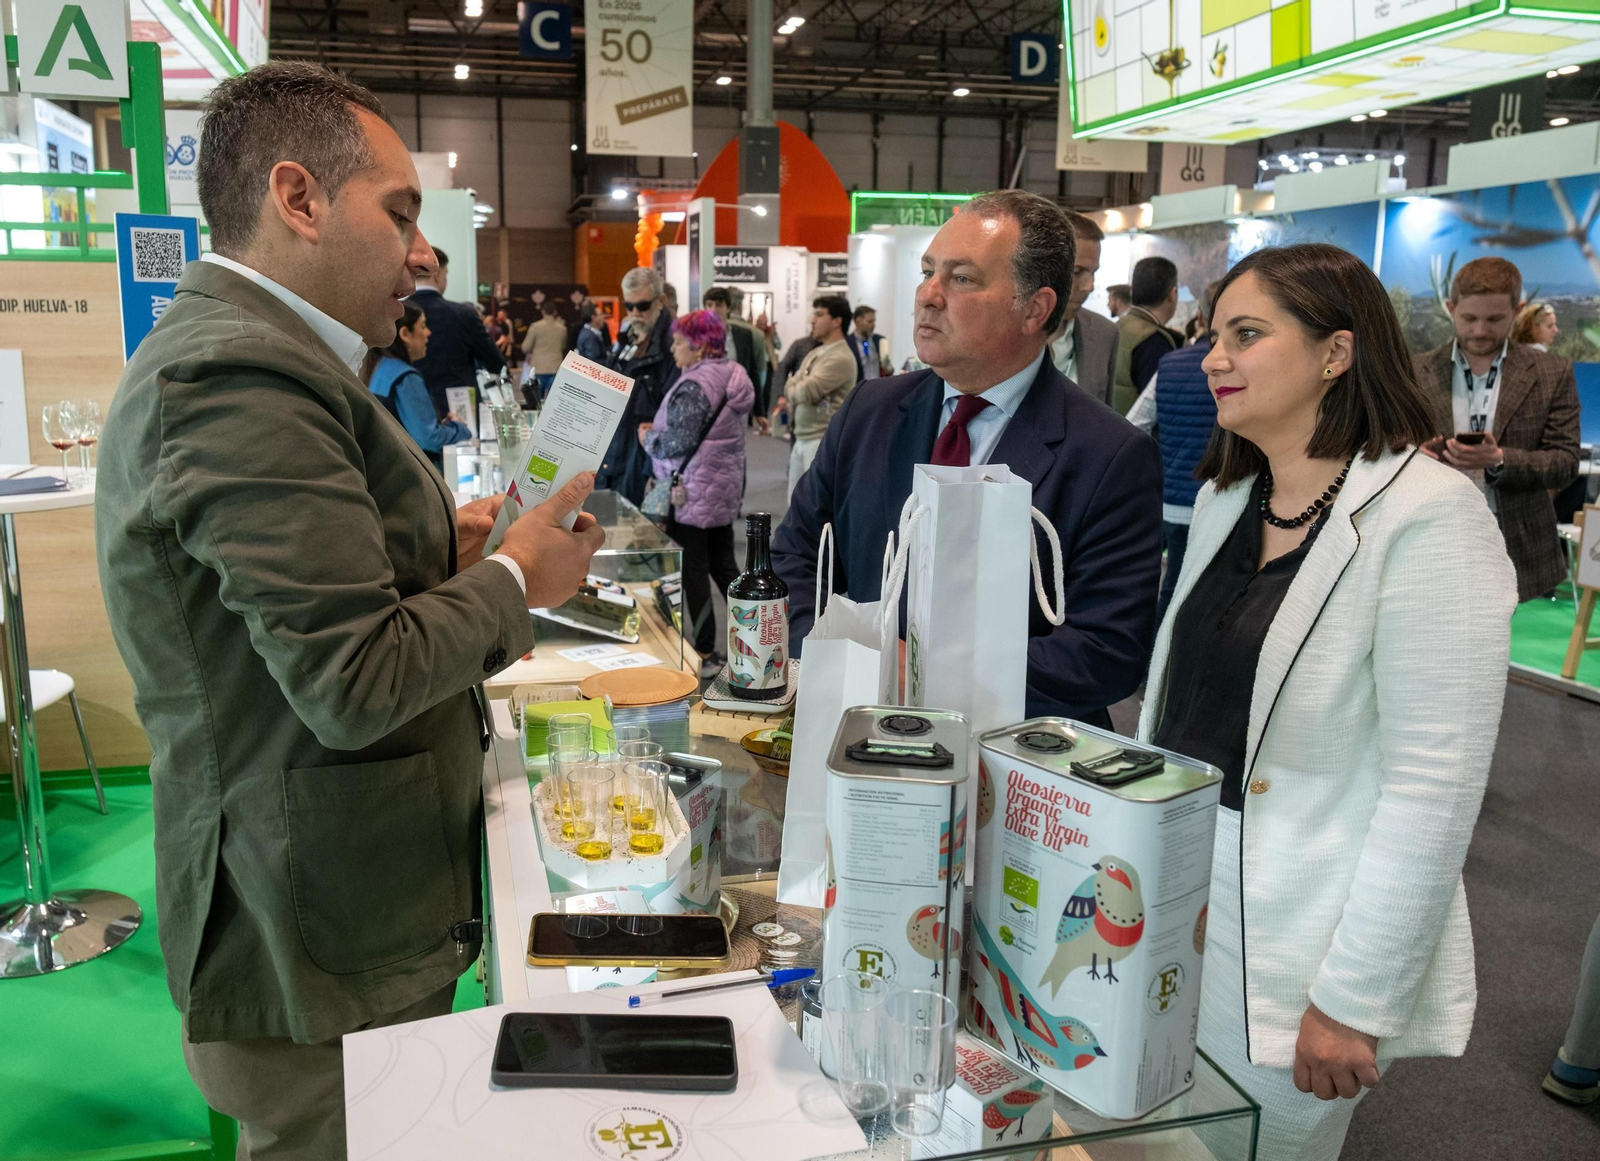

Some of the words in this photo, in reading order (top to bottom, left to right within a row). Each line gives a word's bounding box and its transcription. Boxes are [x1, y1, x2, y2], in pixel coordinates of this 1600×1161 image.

[531, 10, 561, 51] C
[598, 12, 657, 23] cumplimos
[600, 29, 653, 64] 50
[1020, 40, 1048, 77] D
[0, 300, 21, 313] DIP.
[1006, 786, 1062, 820] Organic
[1007, 769, 1093, 817] Oleosierra
[1004, 814, 1039, 842] Olive
[1042, 830, 1064, 853] Oil
[1005, 799, 1041, 827] Extra
[1045, 814, 1091, 848] Virgin
[856, 949, 883, 978] E
[1159, 967, 1178, 997] E
[624, 1119, 673, 1151] E
